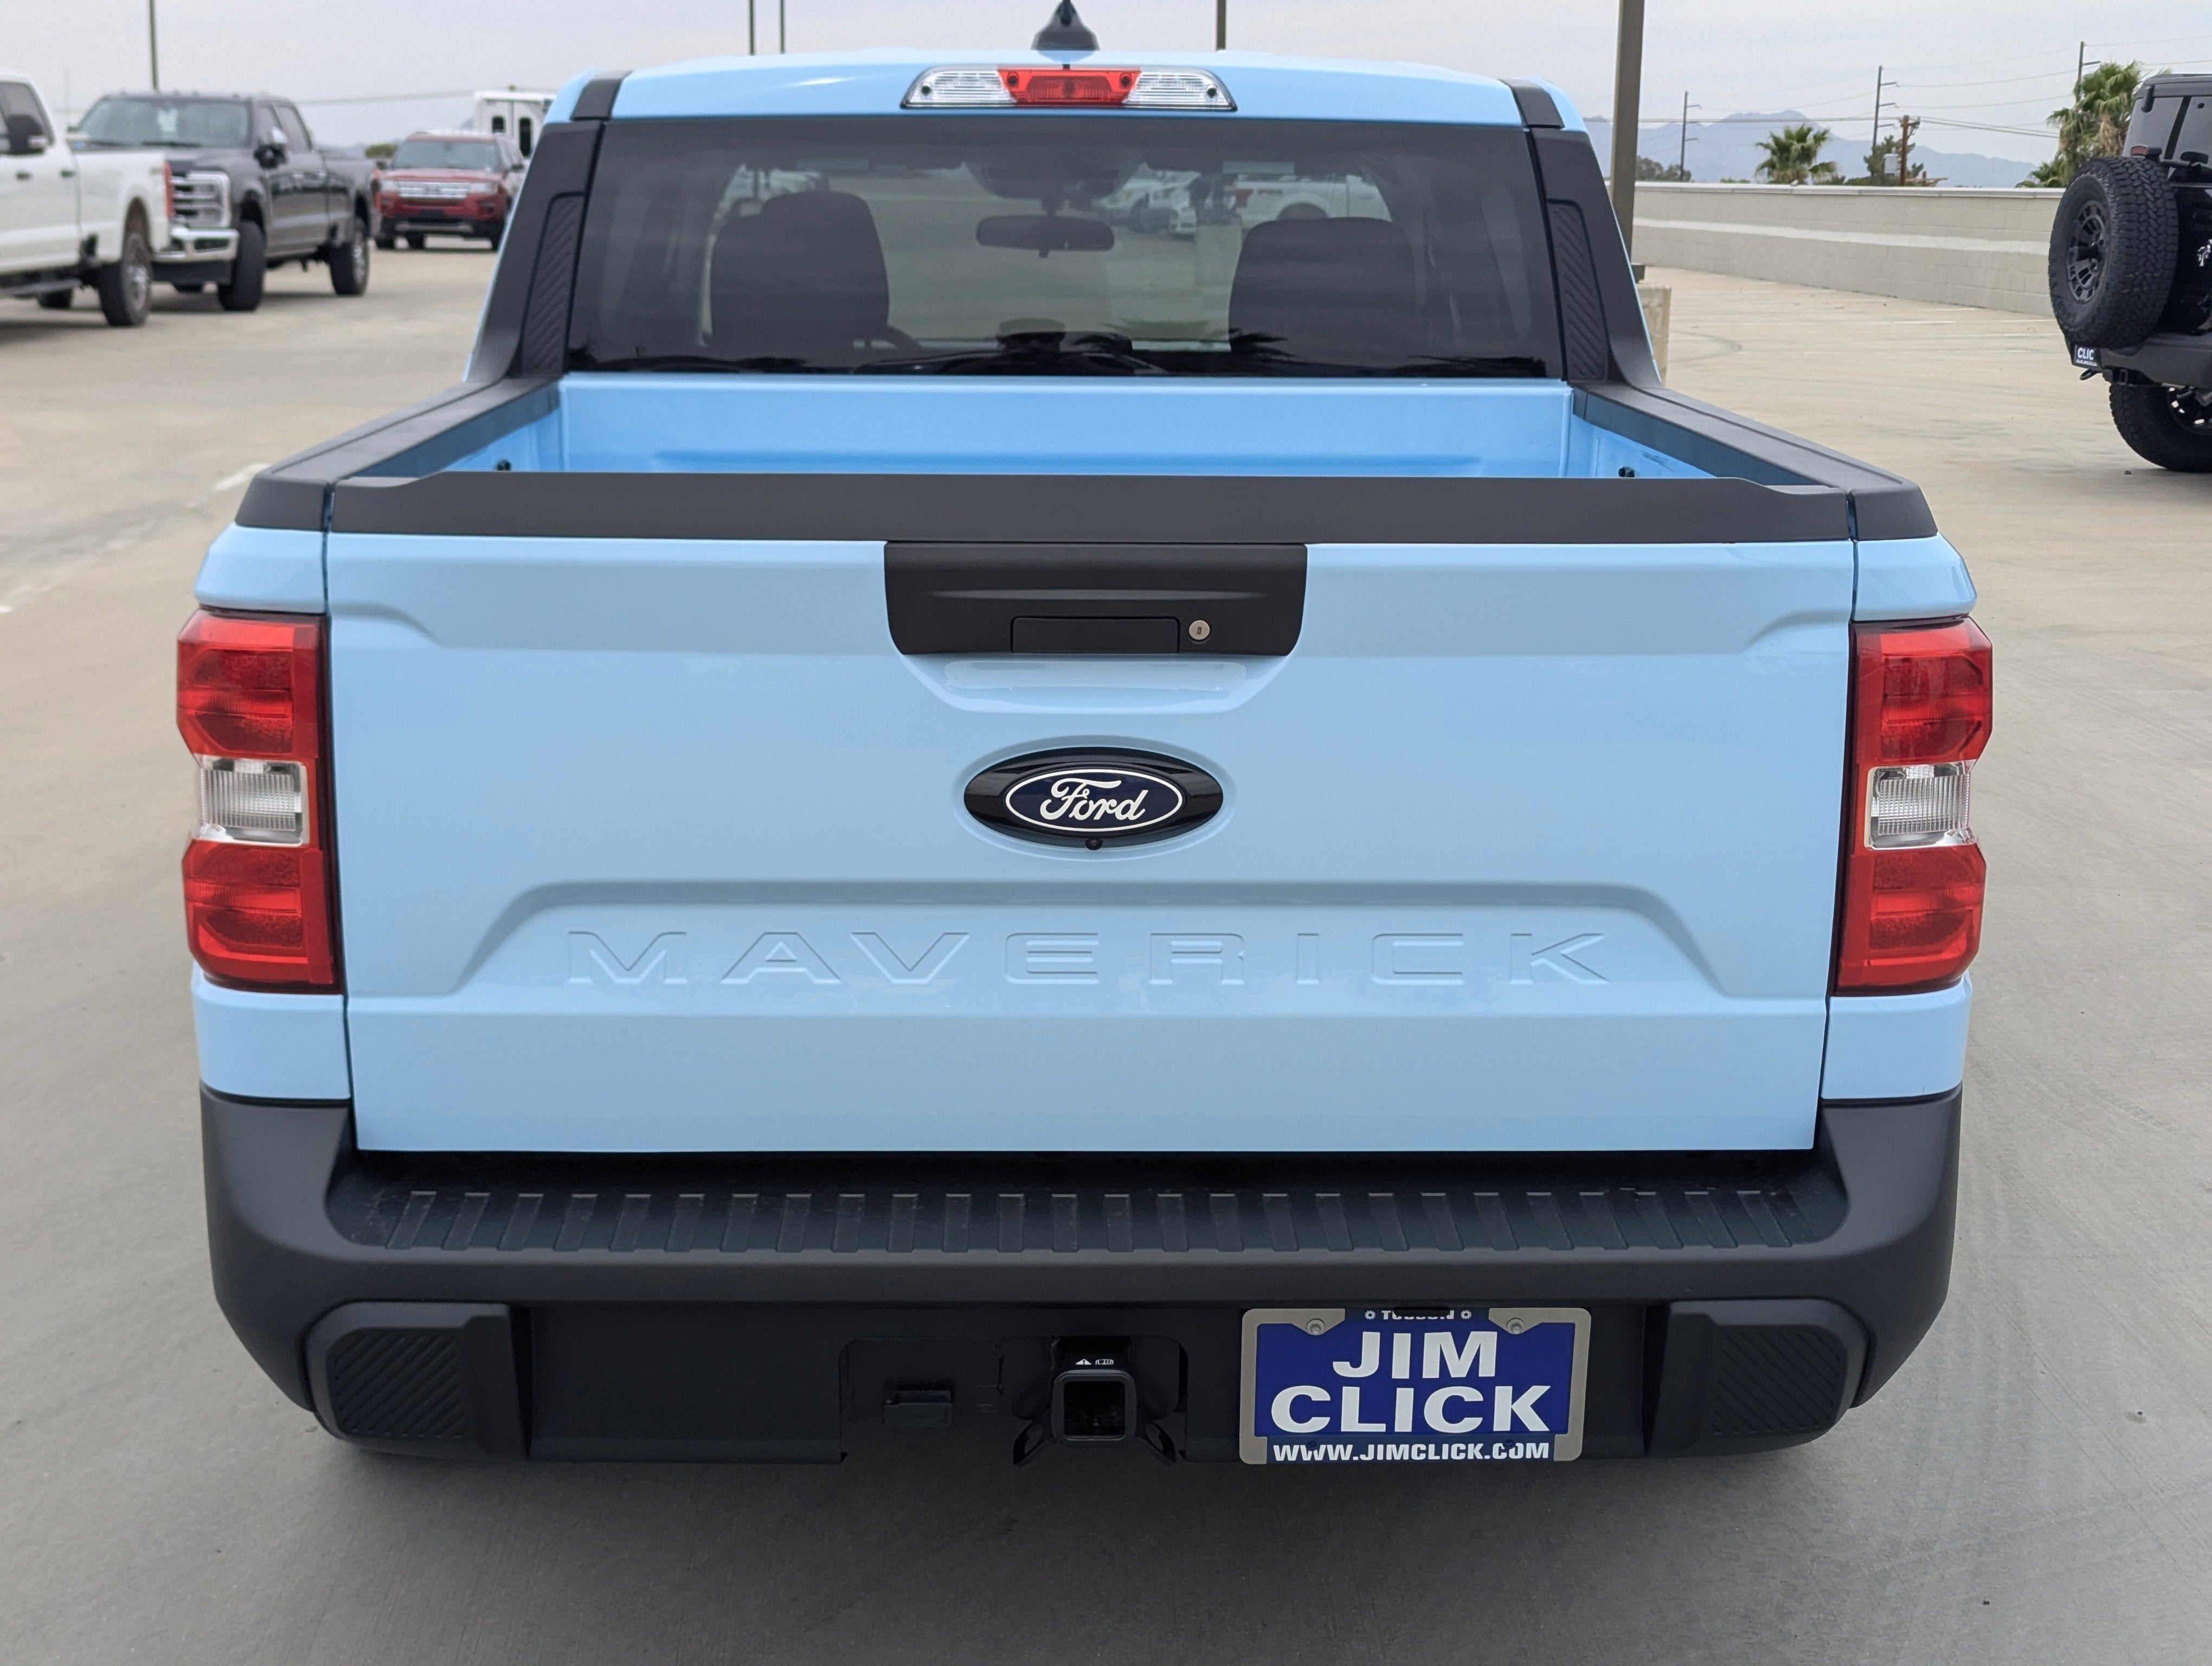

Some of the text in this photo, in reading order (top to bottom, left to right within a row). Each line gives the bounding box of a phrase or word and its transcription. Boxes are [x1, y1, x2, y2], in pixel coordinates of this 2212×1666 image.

[2078, 347, 2094, 360] CLIC
[1040, 778, 1148, 821] Ford
[568, 931, 1609, 984] MAVERICK
[1332, 1331, 1497, 1379] JIM
[1271, 1385, 1551, 1433] CLICK
[1273, 1442, 1549, 1462] WWW.JIMCLICK.COM
